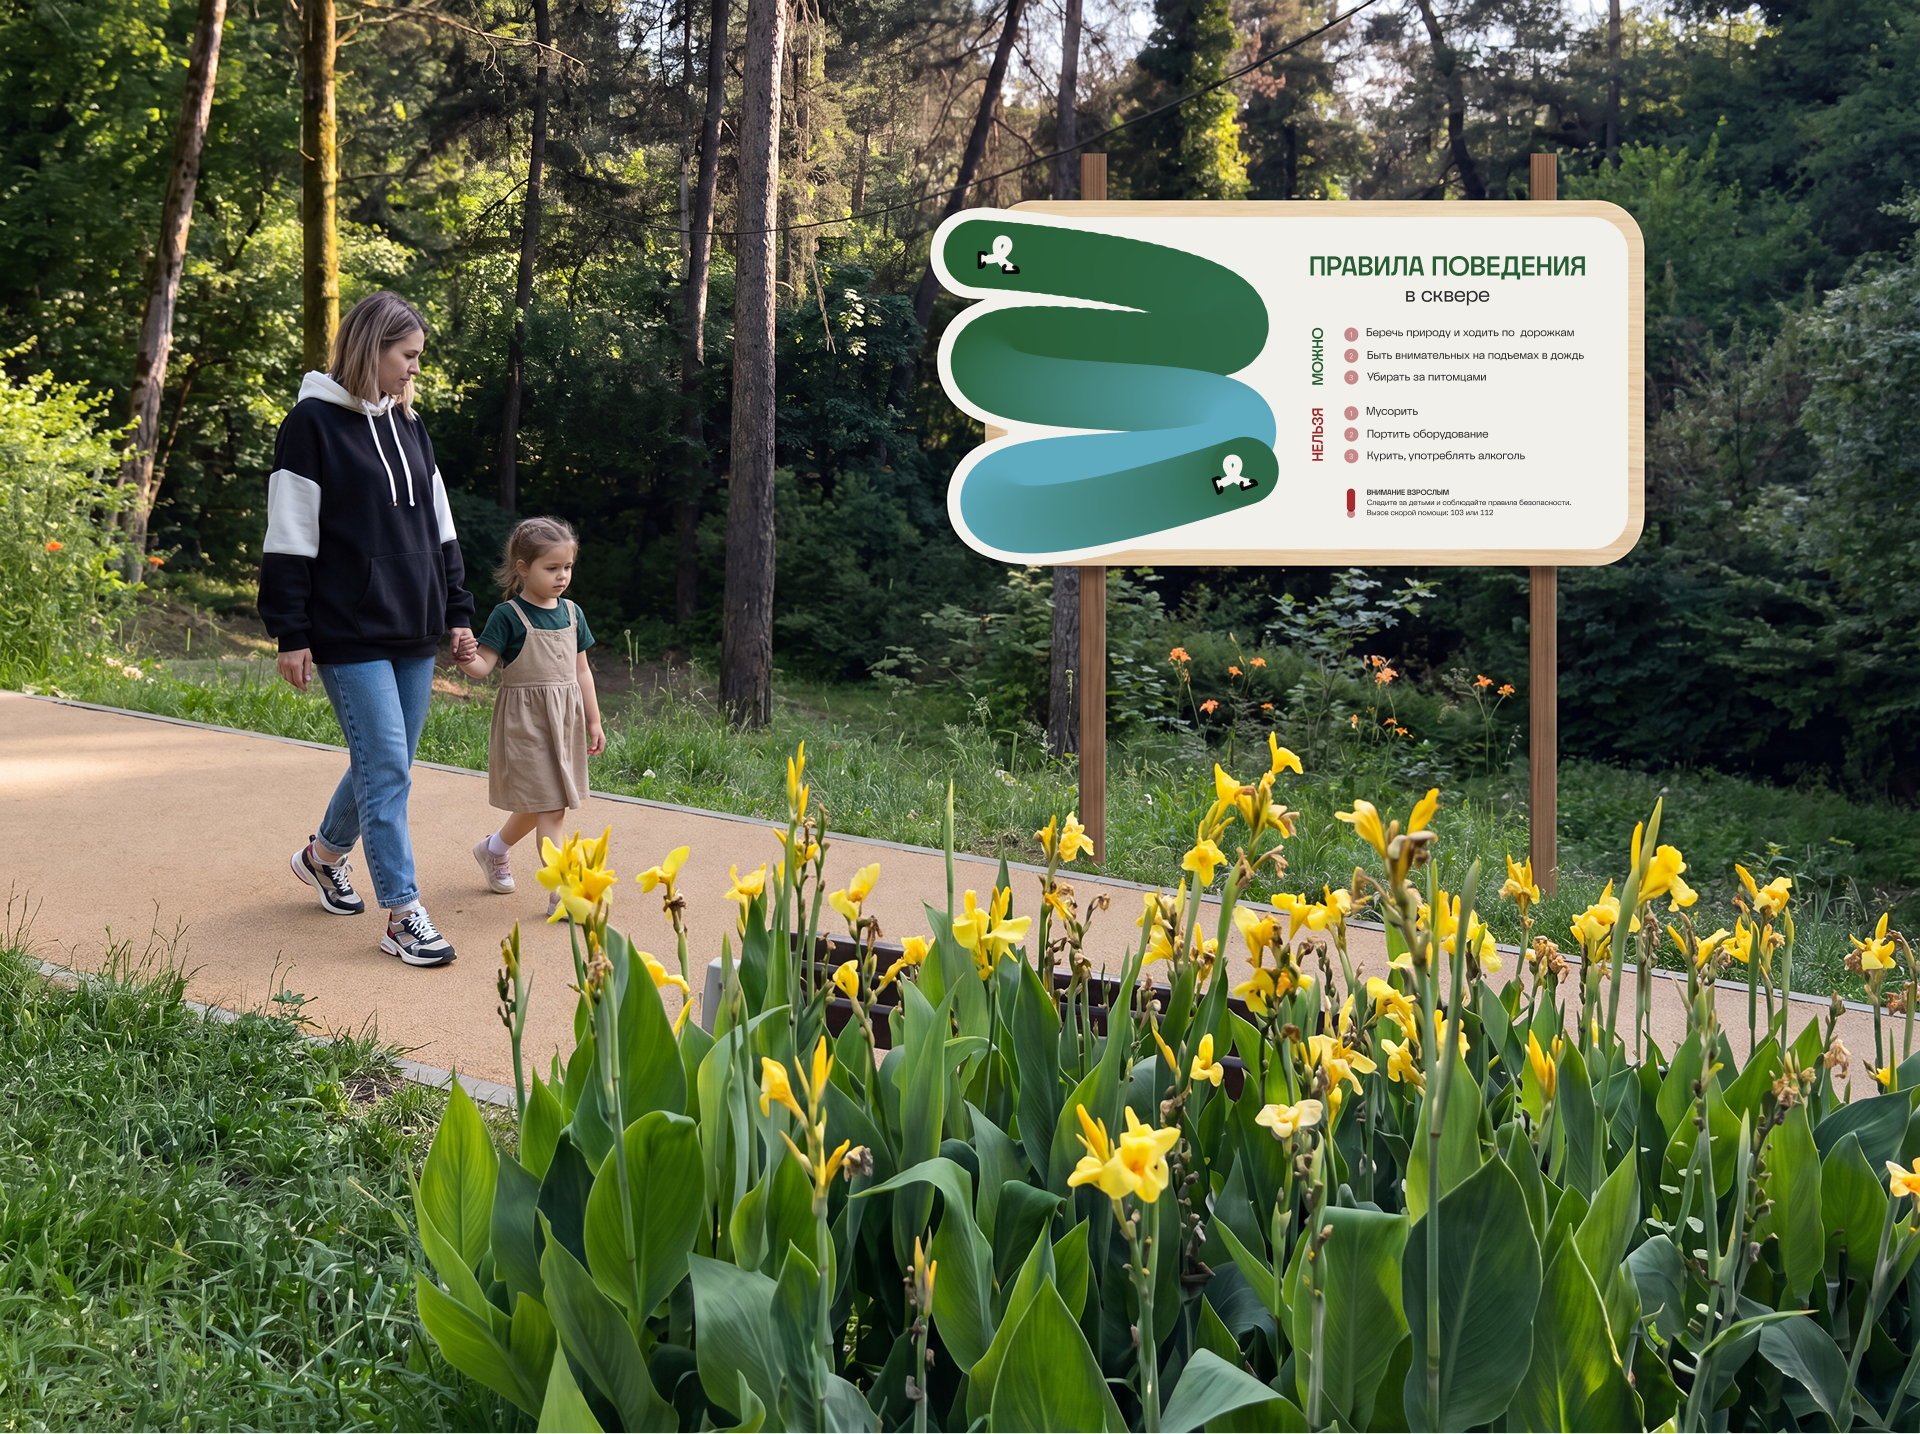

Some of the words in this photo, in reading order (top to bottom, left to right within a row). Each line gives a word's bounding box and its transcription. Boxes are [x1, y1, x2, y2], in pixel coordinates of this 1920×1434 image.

[1309, 255, 1425, 277] ПРАВИЛА
[1431, 255, 1586, 280] ПОВЕДЕНИЯ
[1405, 290, 1416, 303] в
[1420, 290, 1490, 306] сквере
[1366, 327, 1404, 339] Беречь
[1406, 329, 1451, 339] природу
[1453, 329, 1461, 337] и
[1462, 329, 1500, 339] ходить
[1501, 329, 1515, 337] по
[1520, 329, 1575, 339] дорожкам
[1311, 327, 1324, 386] МОЖНО
[1366, 350, 1393, 360] Быть
[1395, 352, 1470, 360] внимательных
[1472, 352, 1485, 360] на
[1487, 352, 1540, 361] подъемах
[1541, 352, 1548, 360] в
[1550, 352, 1585, 361] дождь
[1366, 371, 1411, 383] Убирать
[1413, 374, 1426, 382] за
[1427, 374, 1487, 383] питомцами
[1366, 406, 1419, 418] Мусорить
[1311, 407, 1324, 462] НЕЛЬЗЯ
[1366, 429, 1411, 440] Портить
[1412, 429, 1489, 440] оборудование
[1366, 450, 1407, 462] Курить,
[1408, 450, 1476, 462] употреблять
[1477, 452, 1526, 461] алкоголь
[1366, 488, 1406, 496] ВНИМАНИЕ
[1407, 488, 1450, 496] ВЗРОСЛЫМ
[1366, 499, 1398, 507] Следите
[1442, 499, 1487, 507] соблюдайте
[1366, 509, 1389, 517] Вызов
[1390, 509, 1417, 517] скорой
[1450, 509, 1465, 517] 103
[1480, 509, 1494, 517] 112
